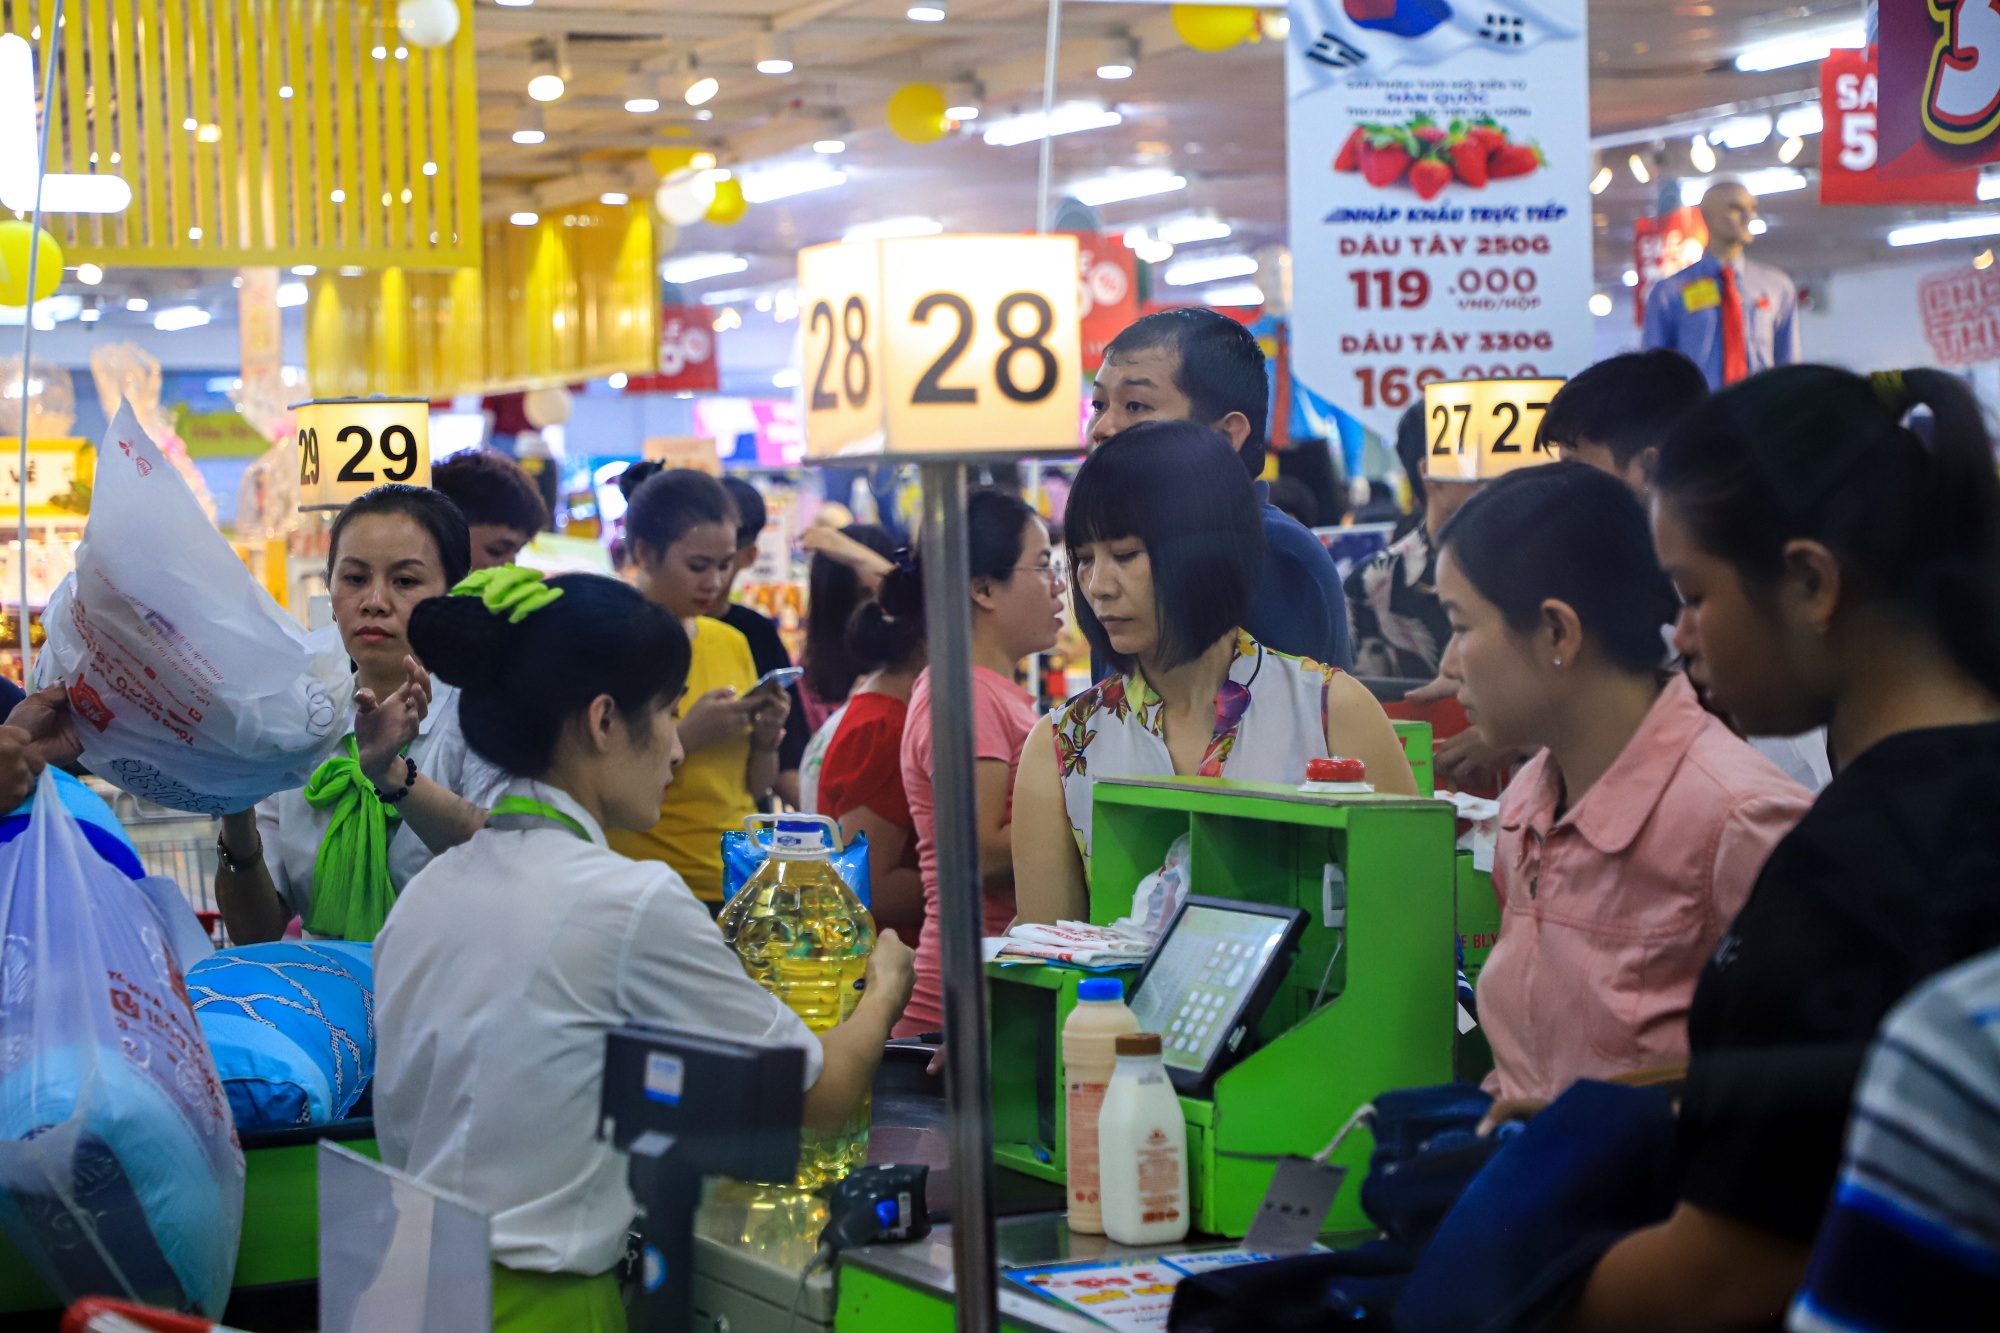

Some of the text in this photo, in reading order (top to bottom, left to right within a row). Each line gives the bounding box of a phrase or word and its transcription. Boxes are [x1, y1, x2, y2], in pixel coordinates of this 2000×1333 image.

[1838, 113, 1878, 170] 5
[1346, 203, 1568, 228] NHẬP KHẨU TRỰC TIẾP
[1339, 234, 1551, 256] DÂU TÂY 250G
[1348, 268, 1431, 310] 119
[811, 296, 869, 411] 28
[911, 292, 1058, 405] 28
[1340, 331, 1553, 354] DÂU TÂY 330G
[1432, 404, 1472, 455] 27
[1492, 402, 1550, 453] 27
[299, 428, 319, 485] 29
[336, 424, 418, 483] 29
